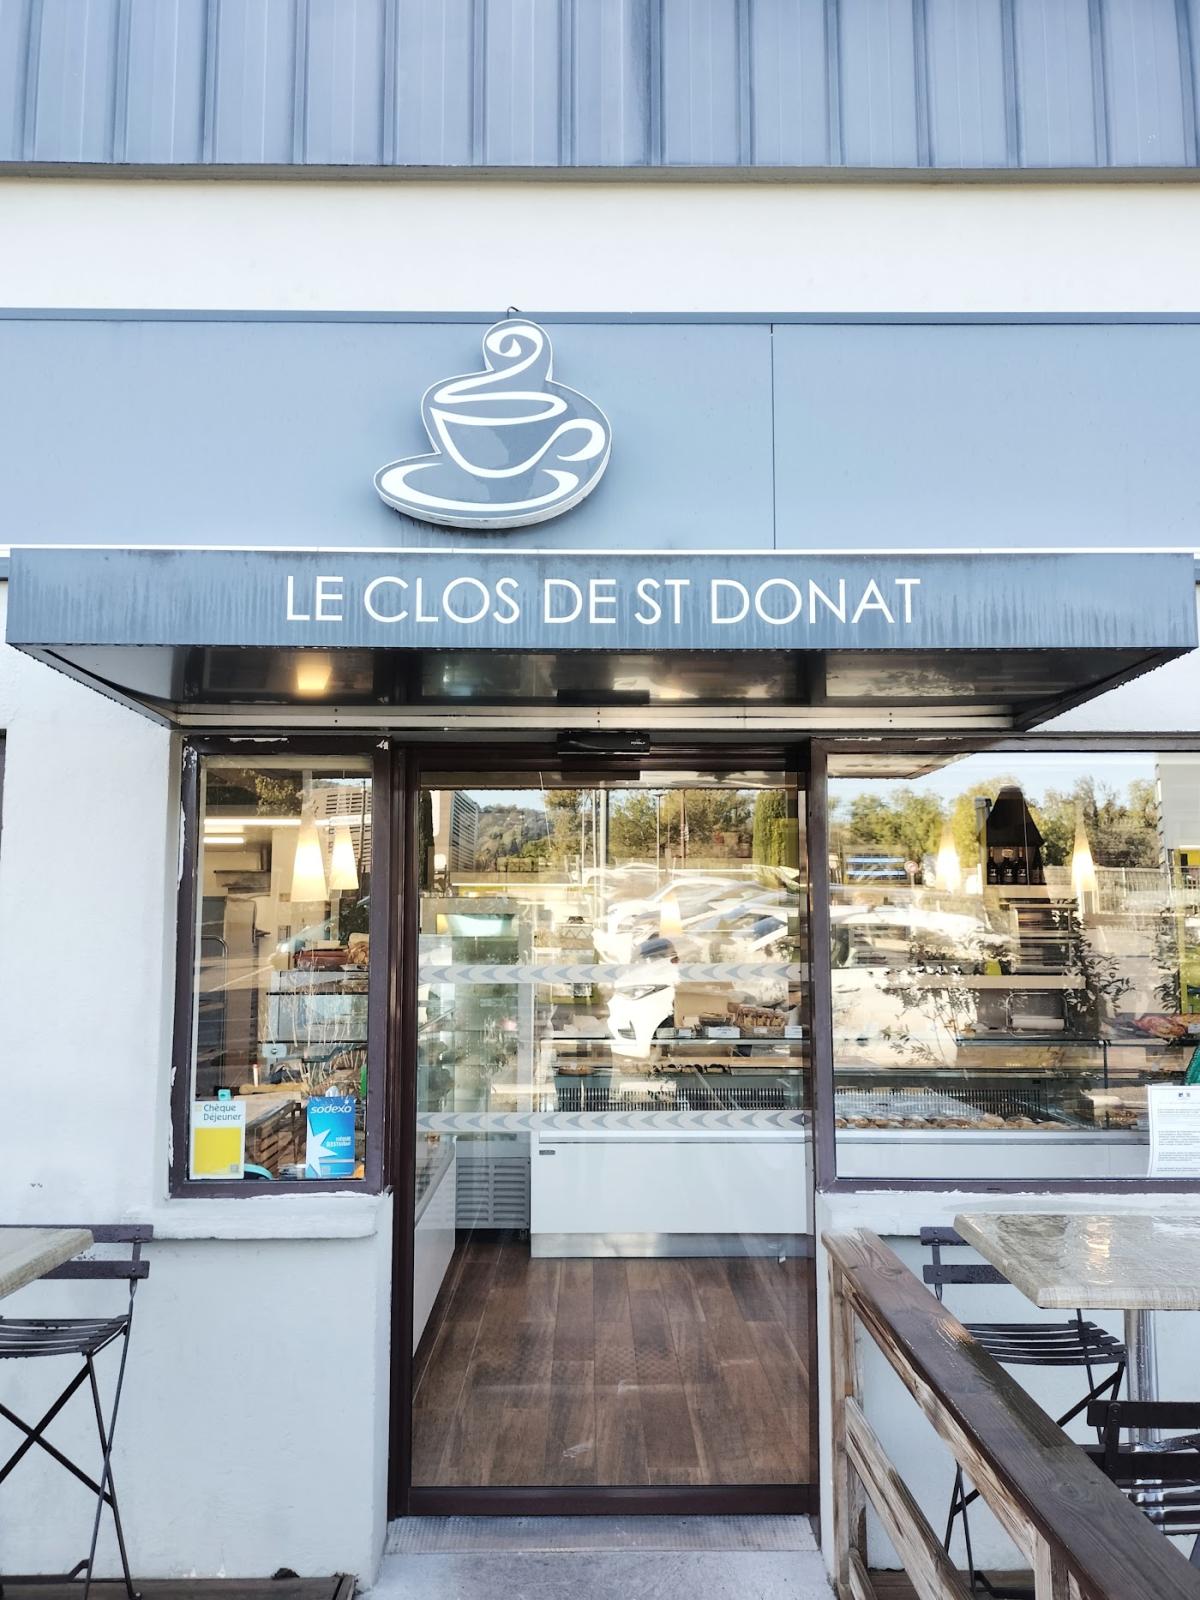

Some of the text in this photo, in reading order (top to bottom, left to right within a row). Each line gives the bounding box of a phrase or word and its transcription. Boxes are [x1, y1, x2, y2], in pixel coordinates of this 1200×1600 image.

[286, 575, 921, 625] LE CLOS DE ST DONAT
[203, 1103, 237, 1113] Chèque
[310, 1104, 352, 1114] sodexo
